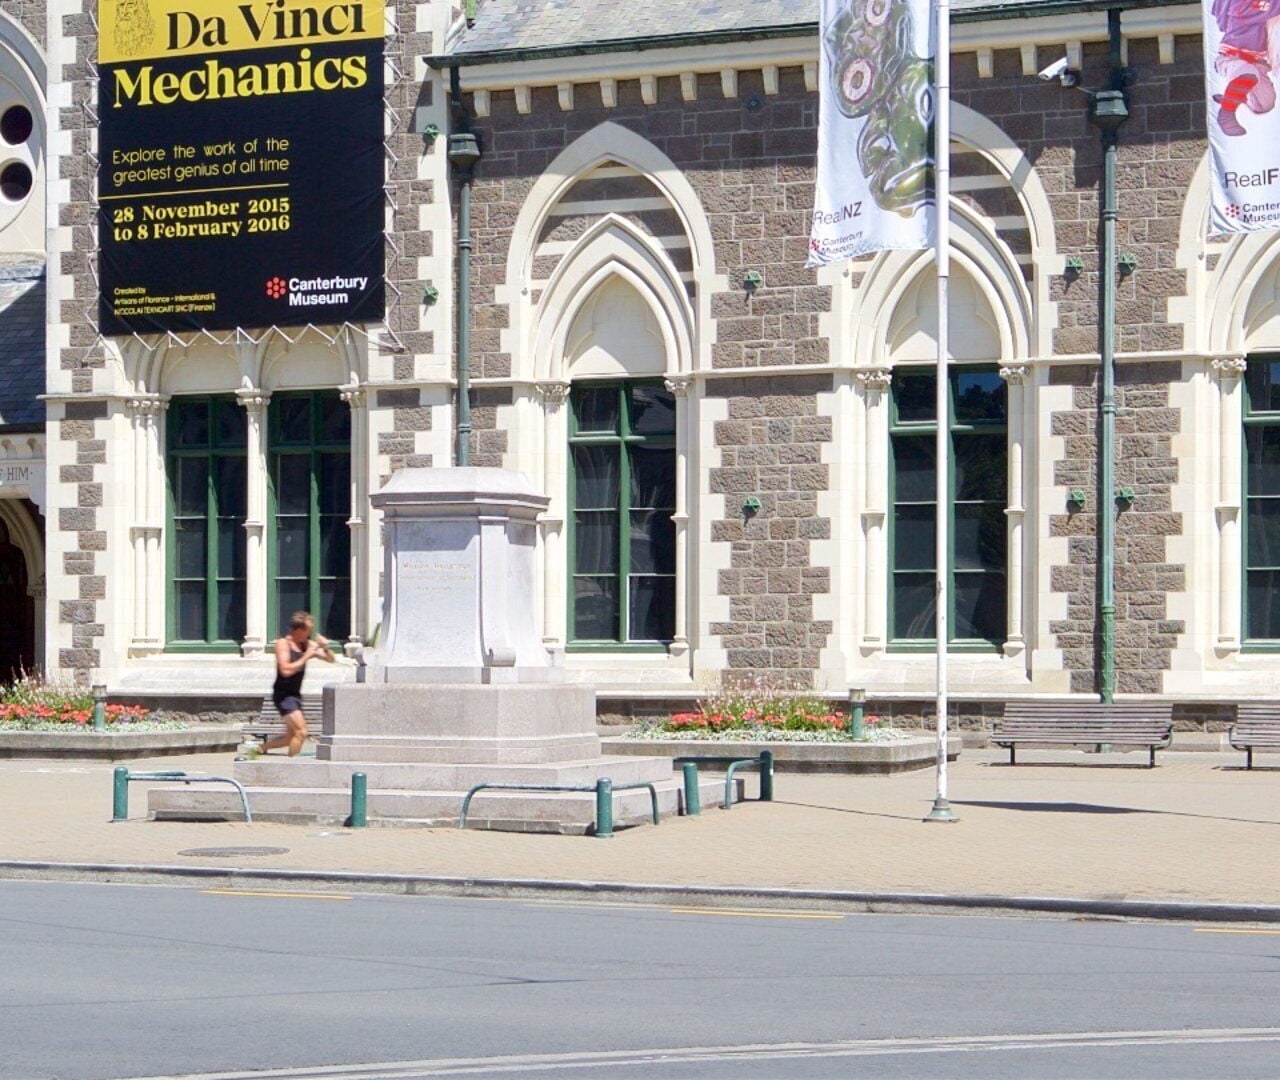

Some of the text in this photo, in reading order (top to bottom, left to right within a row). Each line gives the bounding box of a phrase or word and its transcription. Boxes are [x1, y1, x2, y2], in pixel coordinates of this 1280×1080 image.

[167, 11, 229, 51] Da
[113, 48, 367, 108] Mechanics
[113, 137, 290, 166] Explore the work of the
[113, 158, 290, 187] greatest genius of all time
[113, 197, 290, 224] 28 November 2015
[815, 201, 862, 224] RealNZ
[113, 215, 291, 242] to 8 February 2016
[288, 276, 368, 291] Canterbury
[288, 292, 349, 306] Museum
[7, 467, 29, 481] HIM
